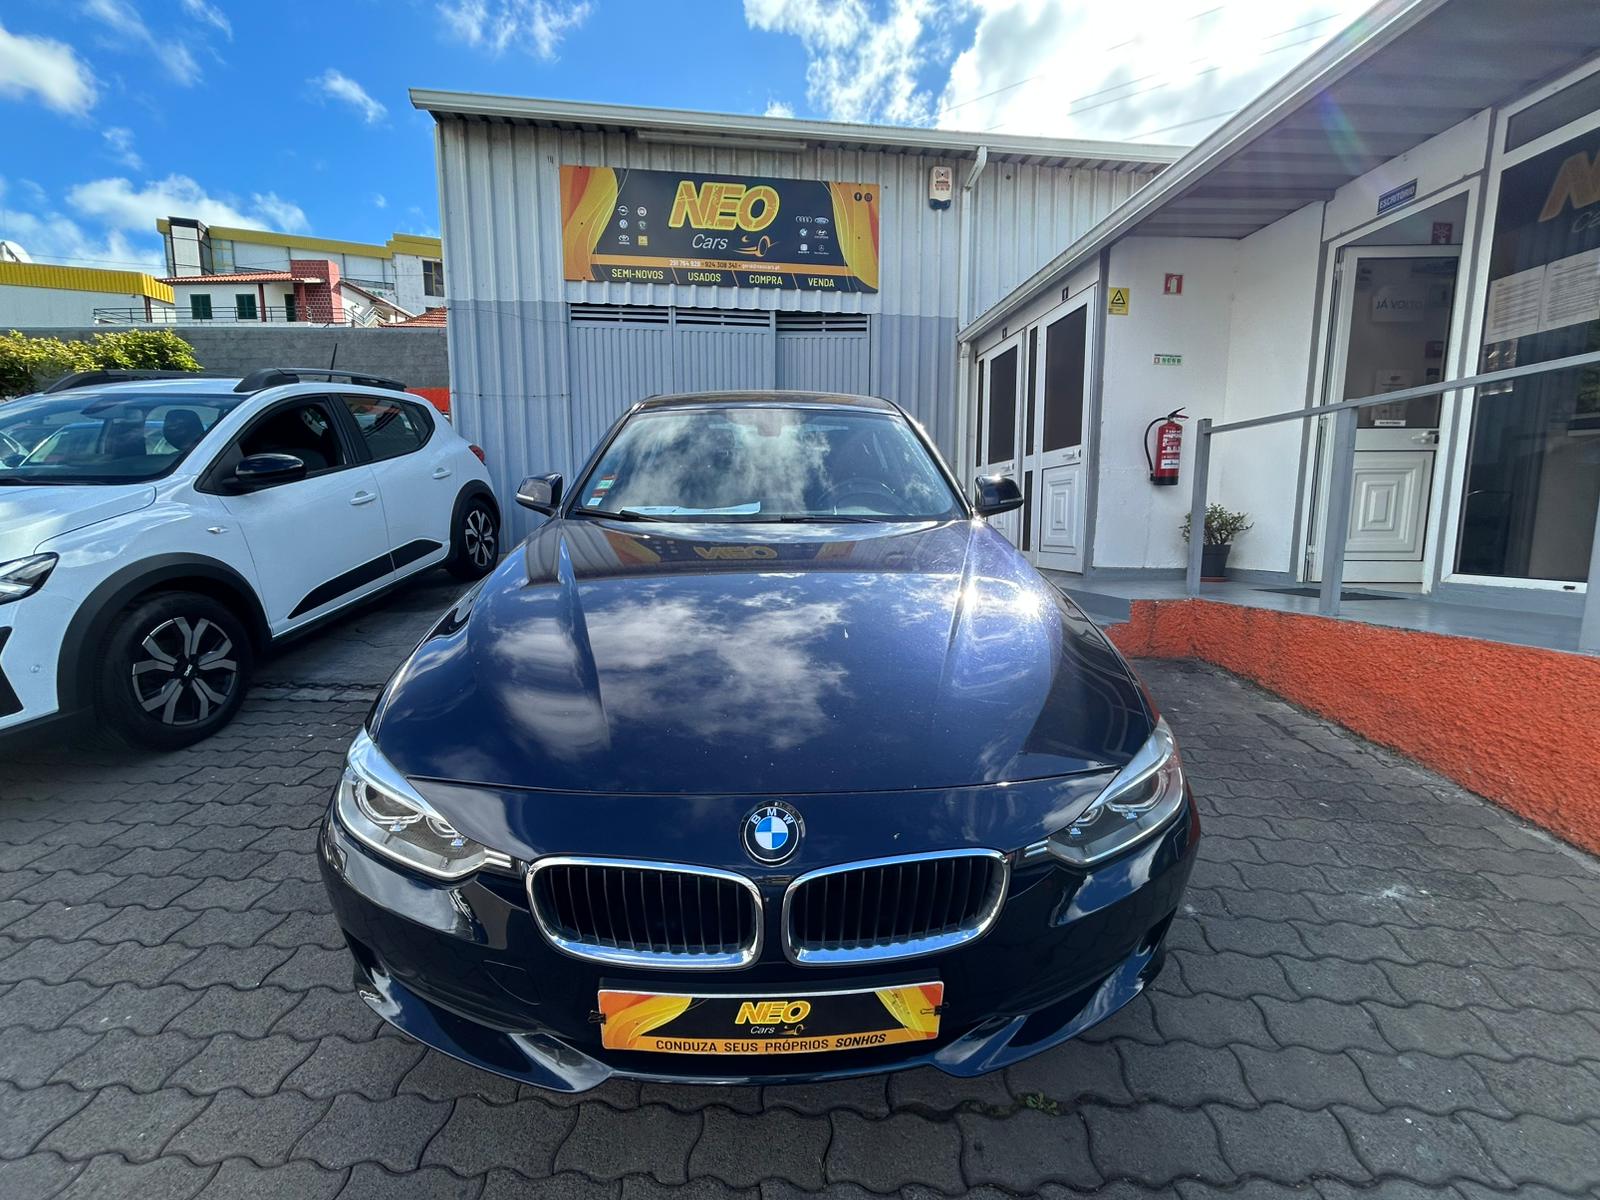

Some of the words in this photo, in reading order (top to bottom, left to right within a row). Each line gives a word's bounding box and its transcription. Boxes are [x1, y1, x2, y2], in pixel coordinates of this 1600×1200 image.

[668, 180, 780, 232] NEO
[692, 233, 729, 250] Cars
[611, 268, 664, 280] SEMI-NOVOS
[687, 272, 722, 283] USADOS
[748, 274, 783, 285] COMPRA
[807, 277, 835, 288] VENDA
[750, 807, 794, 825] BMW
[734, 1001, 811, 1025] NEO
[750, 1026, 775, 1034] Cars
[655, 1040, 718, 1052] CONDUZA
[724, 1042, 759, 1052] SEUS
[764, 1039, 829, 1052] PRÓPRIOS
[835, 1033, 887, 1049] SONHOS
